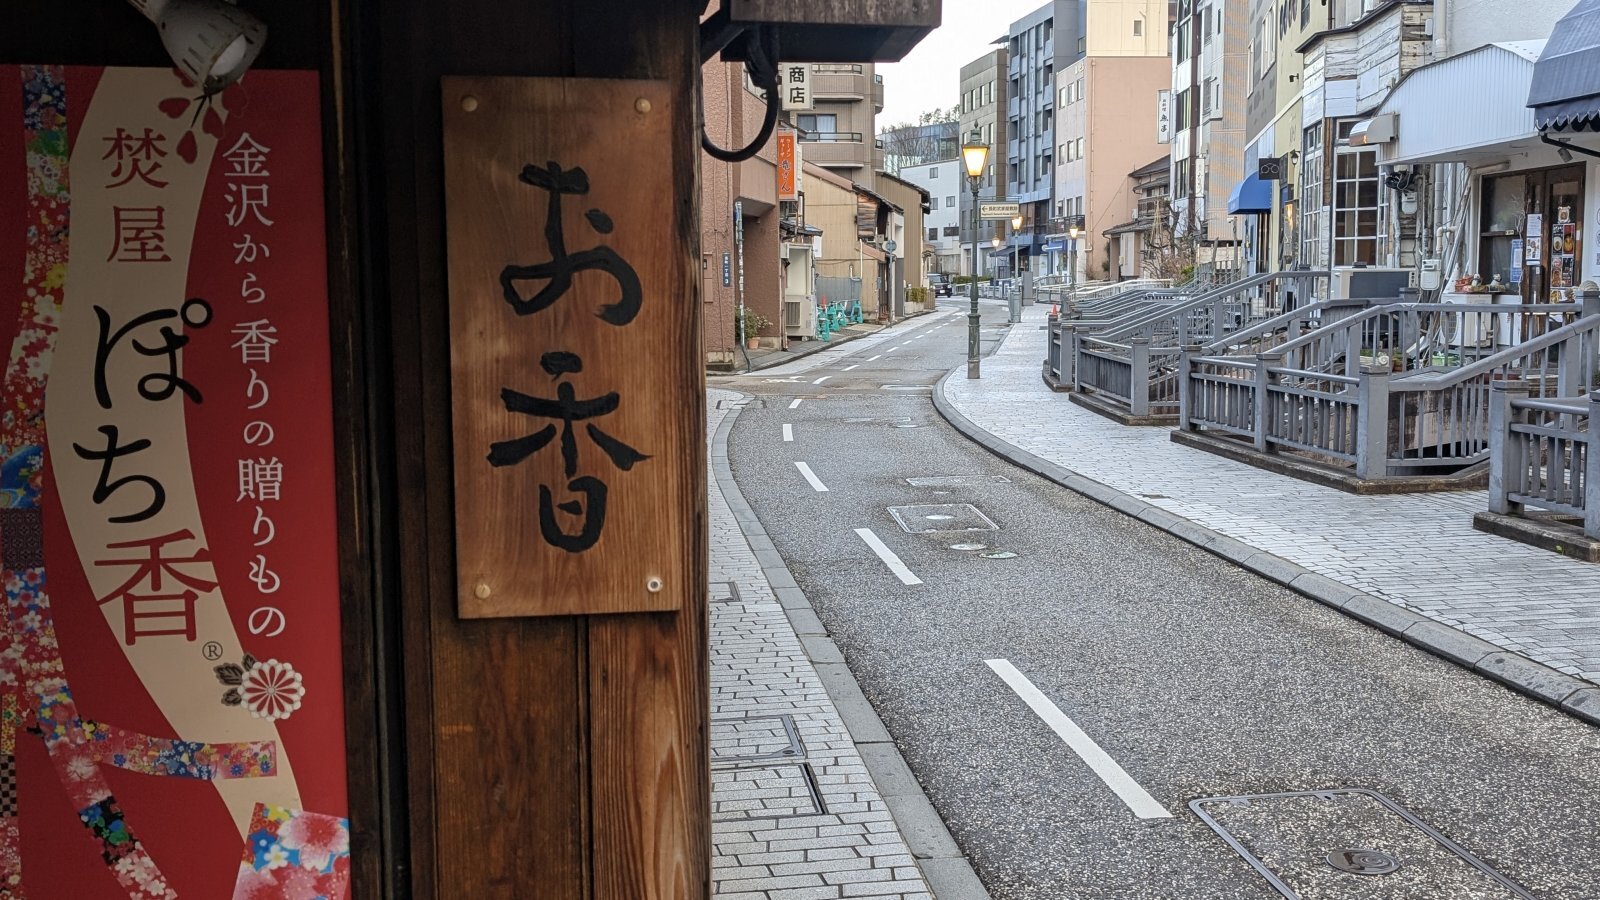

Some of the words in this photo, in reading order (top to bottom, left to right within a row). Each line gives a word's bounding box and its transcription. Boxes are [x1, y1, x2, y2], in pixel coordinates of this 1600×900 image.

[101, 126, 173, 264] 焚屋
[789, 66, 805, 104] 商店
[73, 297, 220, 647] ぽち香
[222, 131, 286, 638] 金沢から香りの贈りもの
[486, 160, 654, 553] お香
